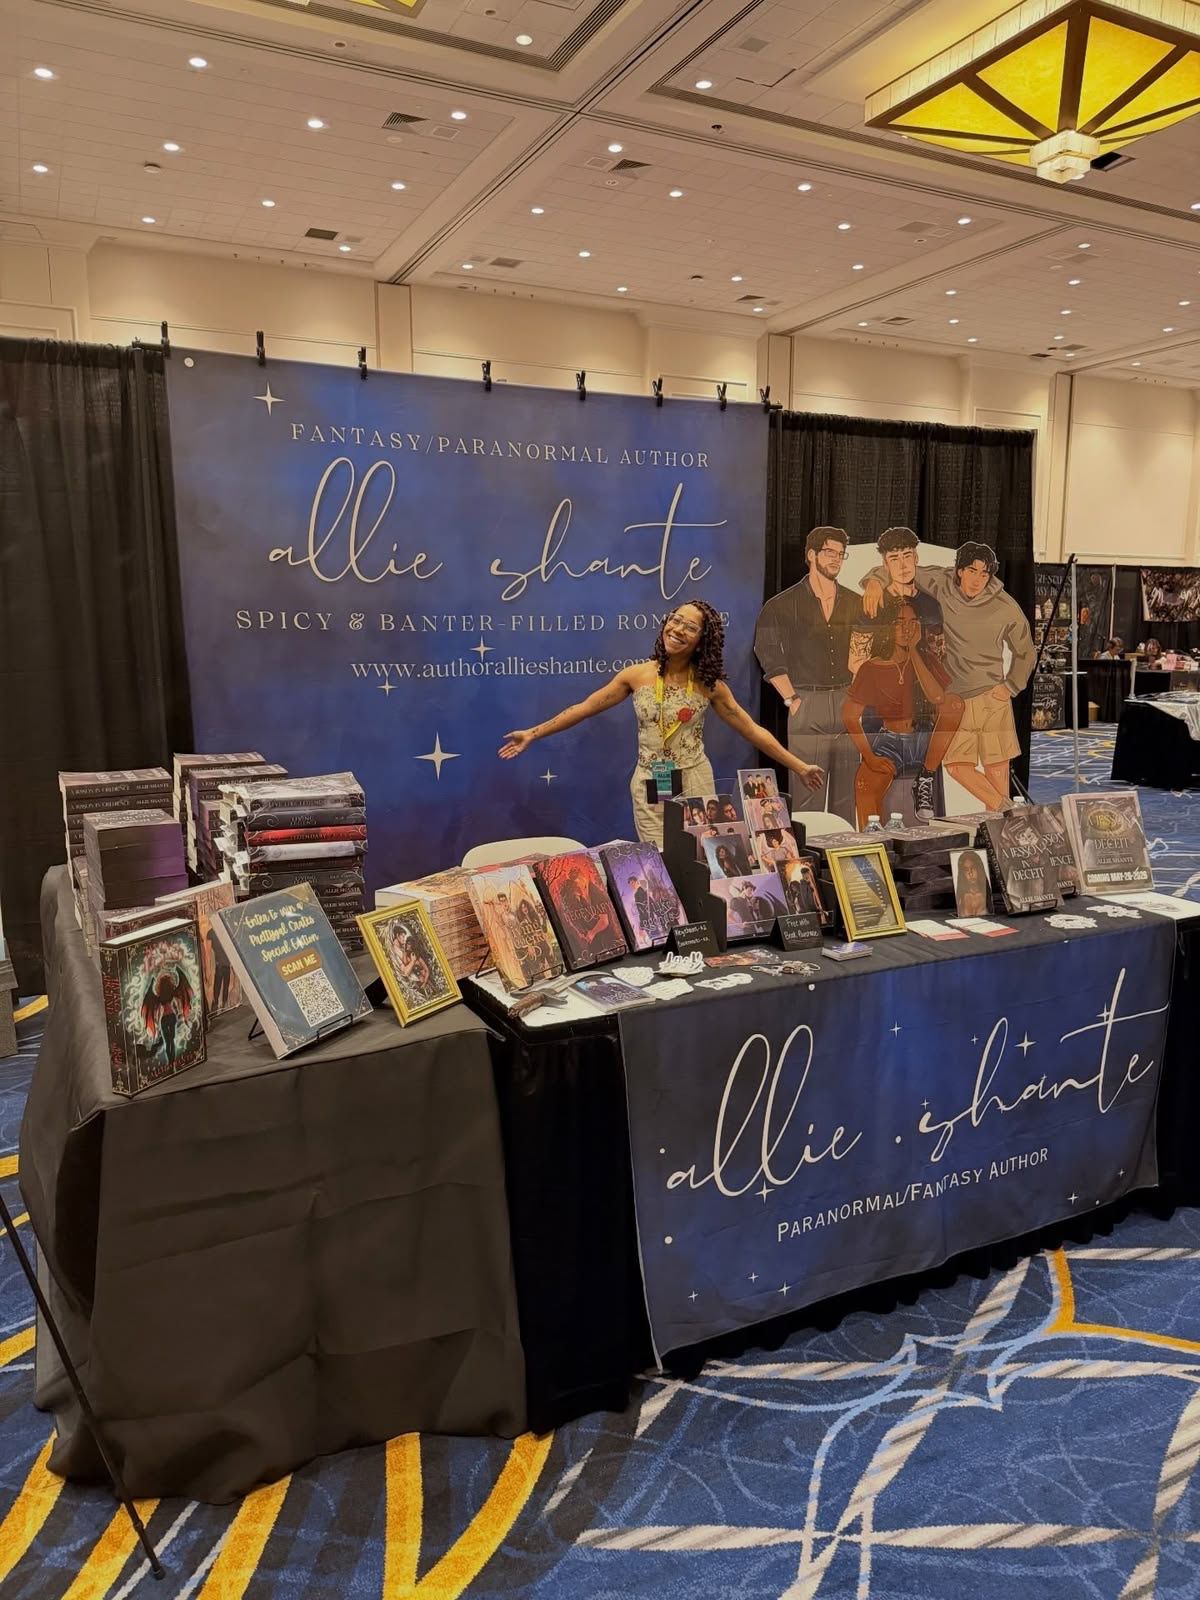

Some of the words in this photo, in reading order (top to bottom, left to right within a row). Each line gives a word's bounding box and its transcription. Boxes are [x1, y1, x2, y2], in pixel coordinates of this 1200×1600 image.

[291, 423, 608, 464] FANTASY/PARANORMAL
[619, 449, 710, 468] AUTHOR
[268, 457, 443, 584] allie
[489, 482, 728, 601] shante
[235, 609, 333, 632] SPICY
[348, 612, 366, 632] &
[379, 613, 605, 632] BANTER-FILLED
[617, 611, 730, 631] ROME
[1094, 838, 1129, 849] DECEIT
[1012, 867, 1046, 881] DECEIT
[1021, 860, 1030, 869] IN
[1087, 873, 1110, 882] COMING
[282, 960, 304, 976] SCAN
[304, 953, 318, 968] ME
[666, 1023, 863, 1198] allie
[919, 967, 1170, 1162] shante
[777, 1166, 984, 1242] PARANORMAL/FANTASY
[988, 1147, 1050, 1179] AUTHOR
